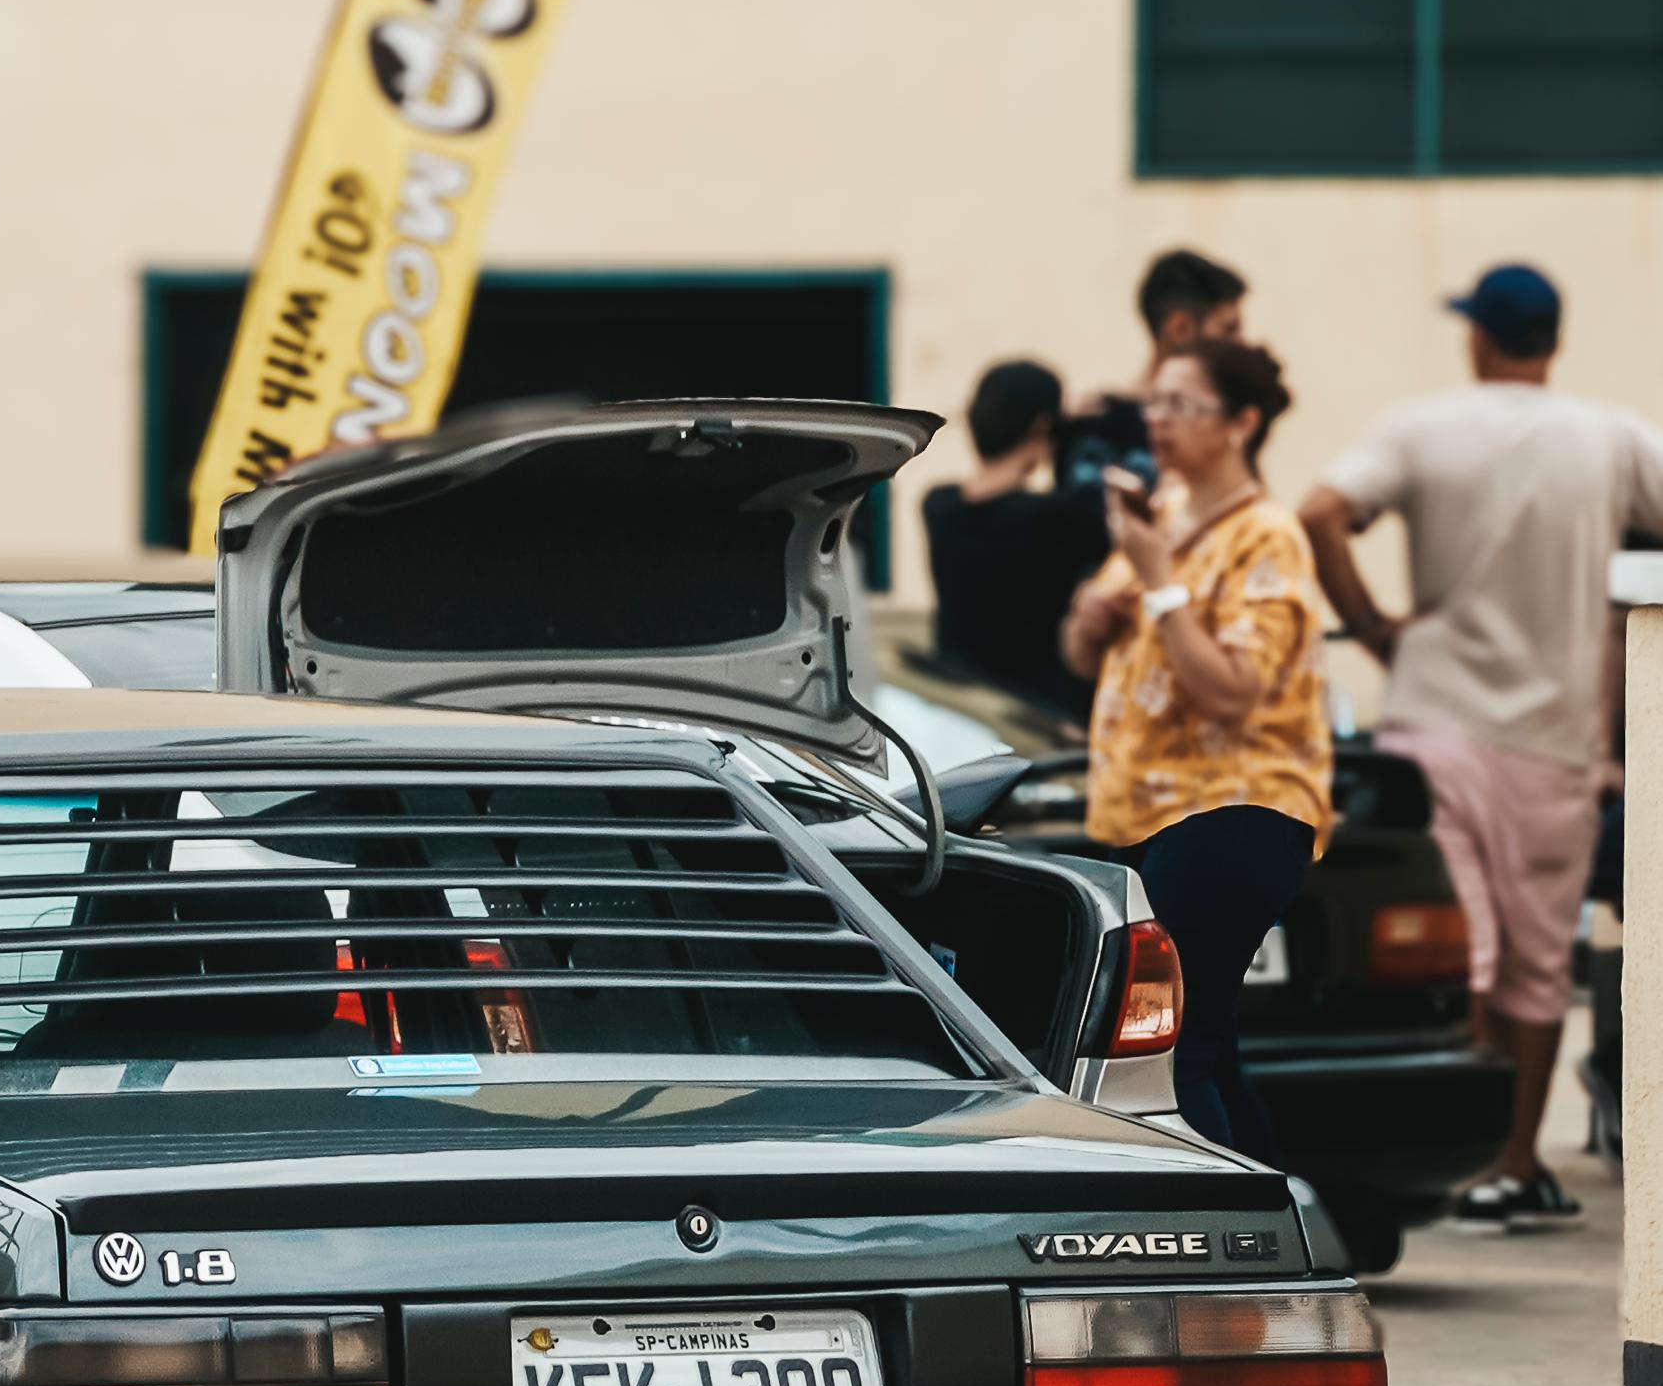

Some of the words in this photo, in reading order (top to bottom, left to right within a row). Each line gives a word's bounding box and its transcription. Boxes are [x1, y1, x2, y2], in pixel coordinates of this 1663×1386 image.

[331, 147, 472, 444] MOON
[258, 289, 328, 411] with
[1017, 1232, 1210, 1262] VOYAGE
[162, 1249, 237, 1285] 1.8
[635, 1332, 750, 1352] SP-CAMPINAS
